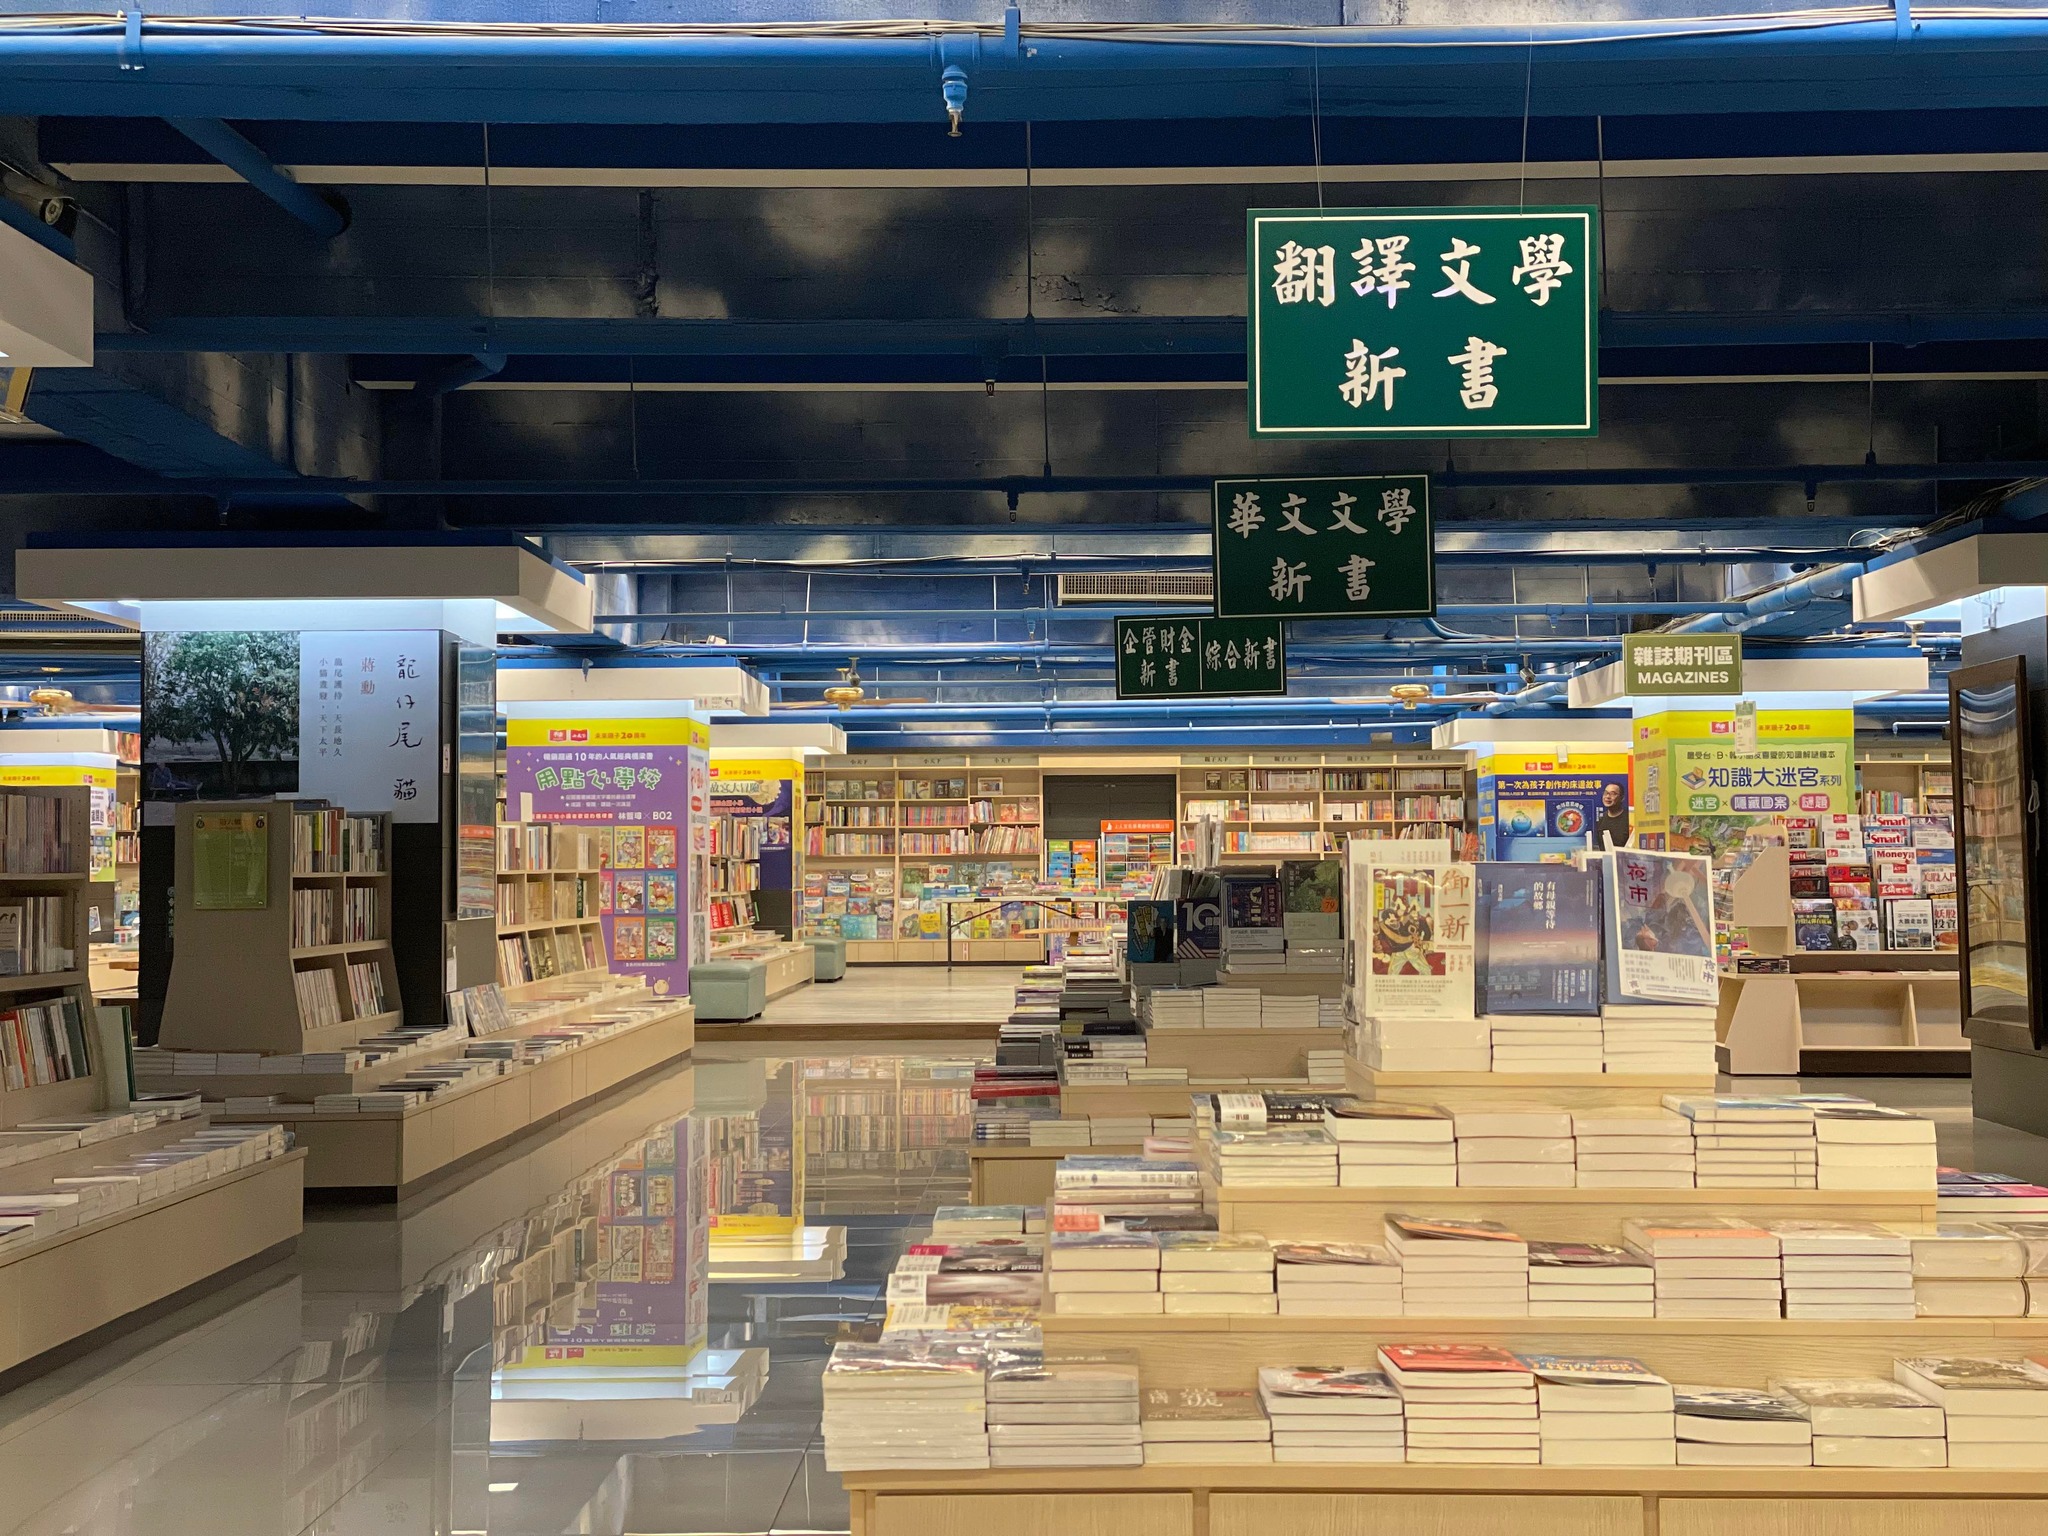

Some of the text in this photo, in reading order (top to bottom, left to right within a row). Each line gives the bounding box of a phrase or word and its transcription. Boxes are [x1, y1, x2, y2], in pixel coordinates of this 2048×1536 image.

[1271, 232, 1574, 310] 翻譯文學
[1338, 336, 1508, 411] 新書
[1226, 487, 1417, 538] 華文文學
[1268, 554, 1376, 603] 新書
[1123, 625, 1195, 655] 企管財金
[1204, 636, 1278, 671] 綜合新書
[1633, 645, 1734, 666] 雜誌期刊區
[1140, 657, 1180, 687] 新書
[1637, 671, 1730, 684] MAGAZINES
[575, 752, 587, 761] 10
[535, 767, 662, 791] 用點心學校
[1498, 780, 1602, 790] 第一次為孩子創作的床邊故事
[1691, 797, 1717, 809] 迷宮
[1801, 797, 1828, 809] 謎題
[1877, 817, 1907, 826] Smart
[1870, 834, 1901, 844] Smart
[1876, 850, 1908, 859] Money
[1533, 881, 1544, 910] 的故鄉
[1627, 862, 1648, 903] 夜市
[1440, 870, 1470, 942] 御一新
[1545, 881, 1556, 929] 有母親等待
[1702, 959, 1716, 983] 夜市
